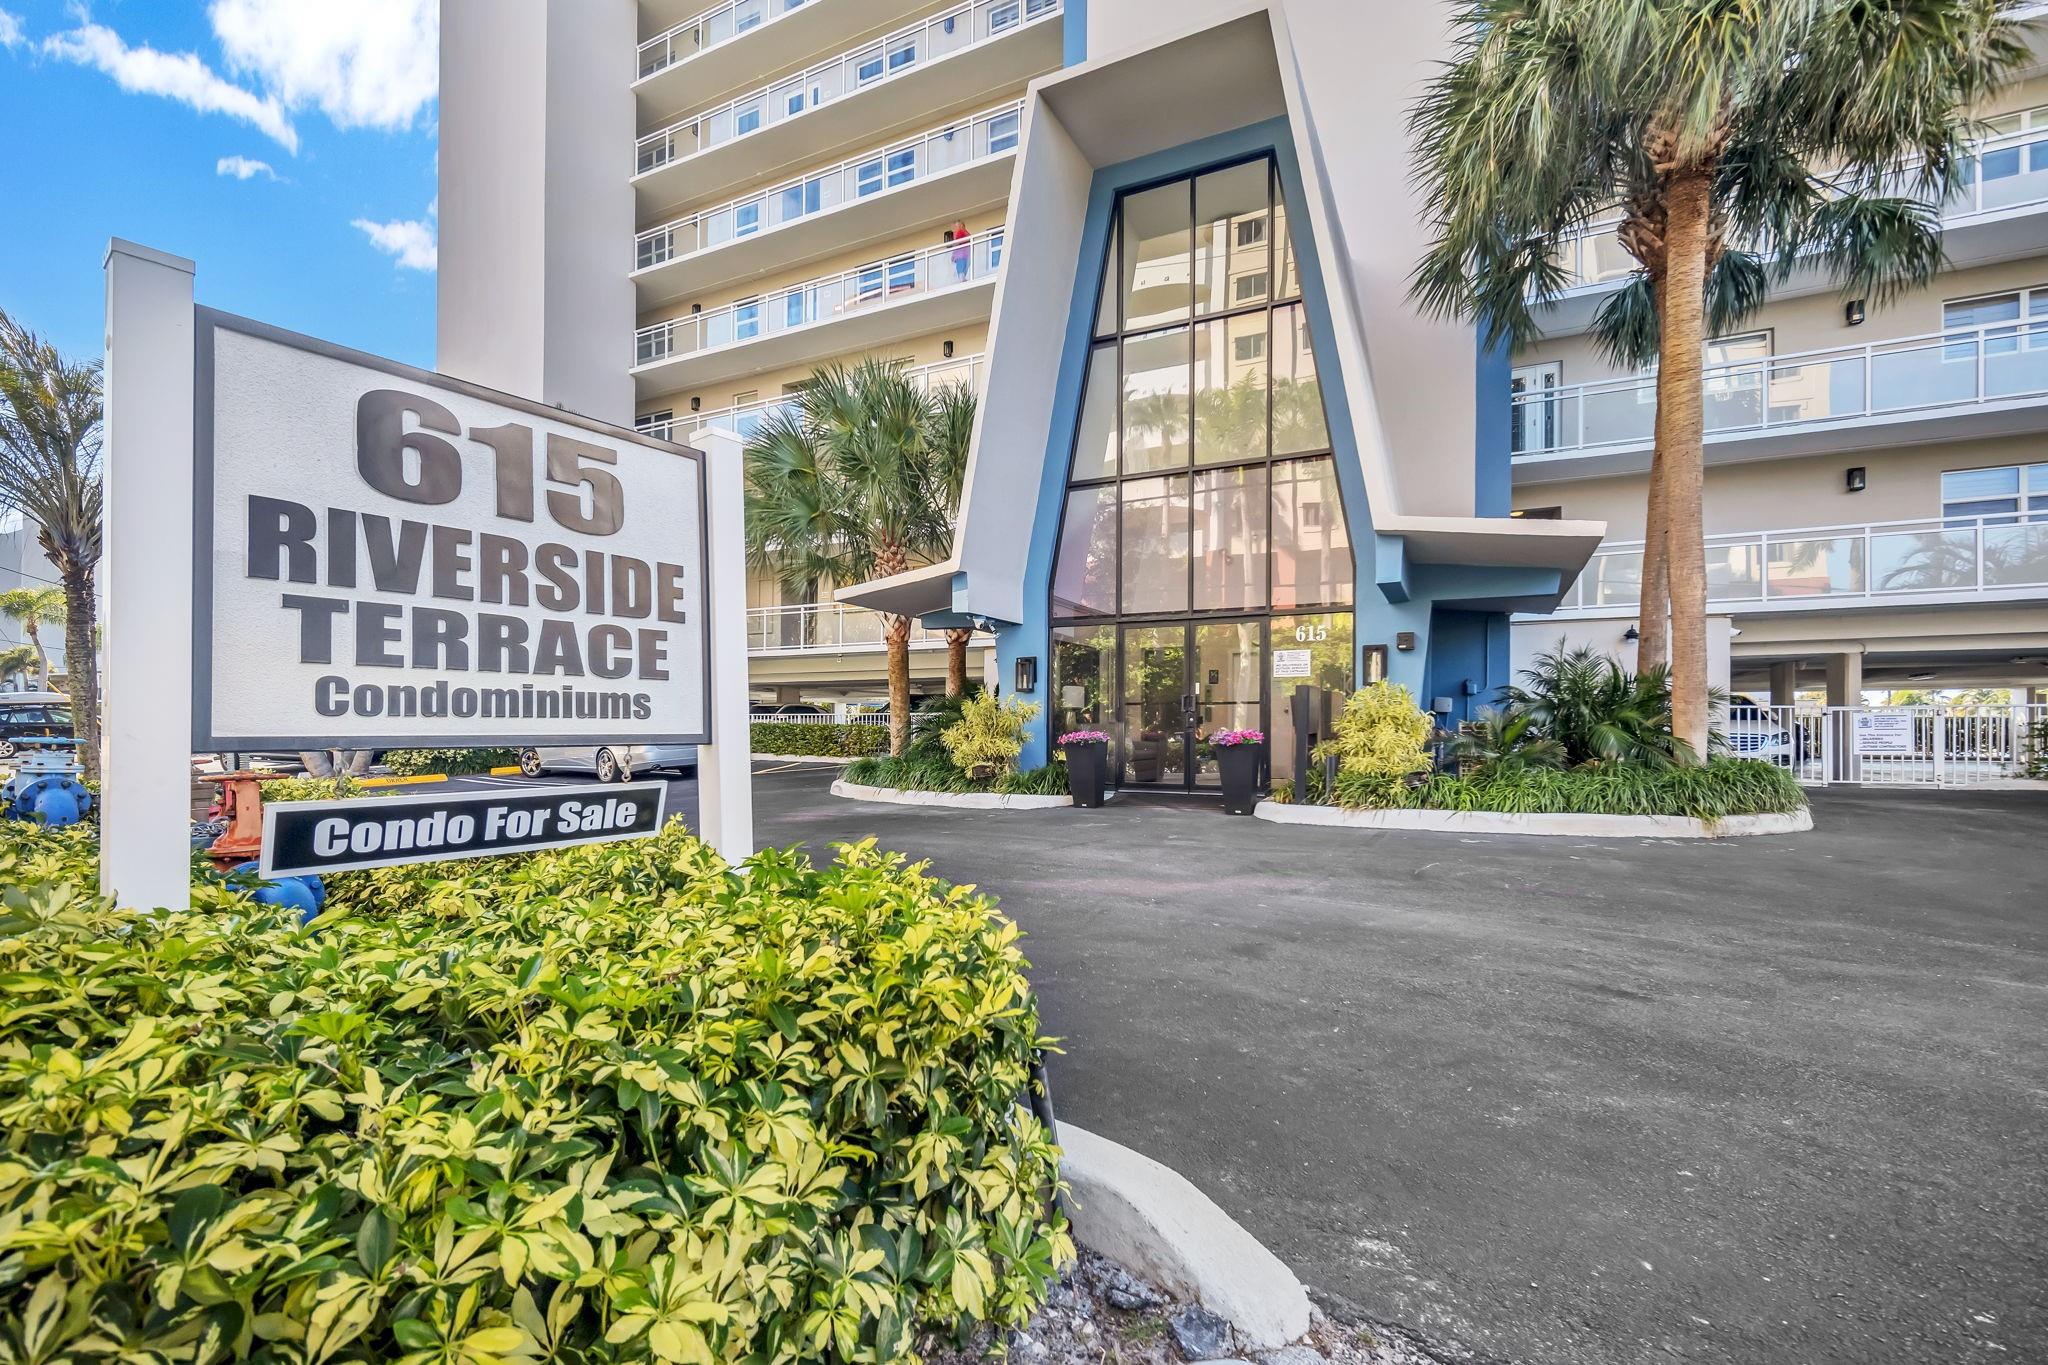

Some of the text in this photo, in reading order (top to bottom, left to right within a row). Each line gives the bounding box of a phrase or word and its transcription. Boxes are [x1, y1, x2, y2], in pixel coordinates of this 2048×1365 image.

[357, 388, 625, 537] 615
[247, 494, 686, 624] RIVERSIDE
[282, 593, 670, 681] TERRACE
[1295, 624, 1328, 642] 615
[314, 675, 652, 720] Condominiums
[313, 798, 637, 858] Condo For Sale
